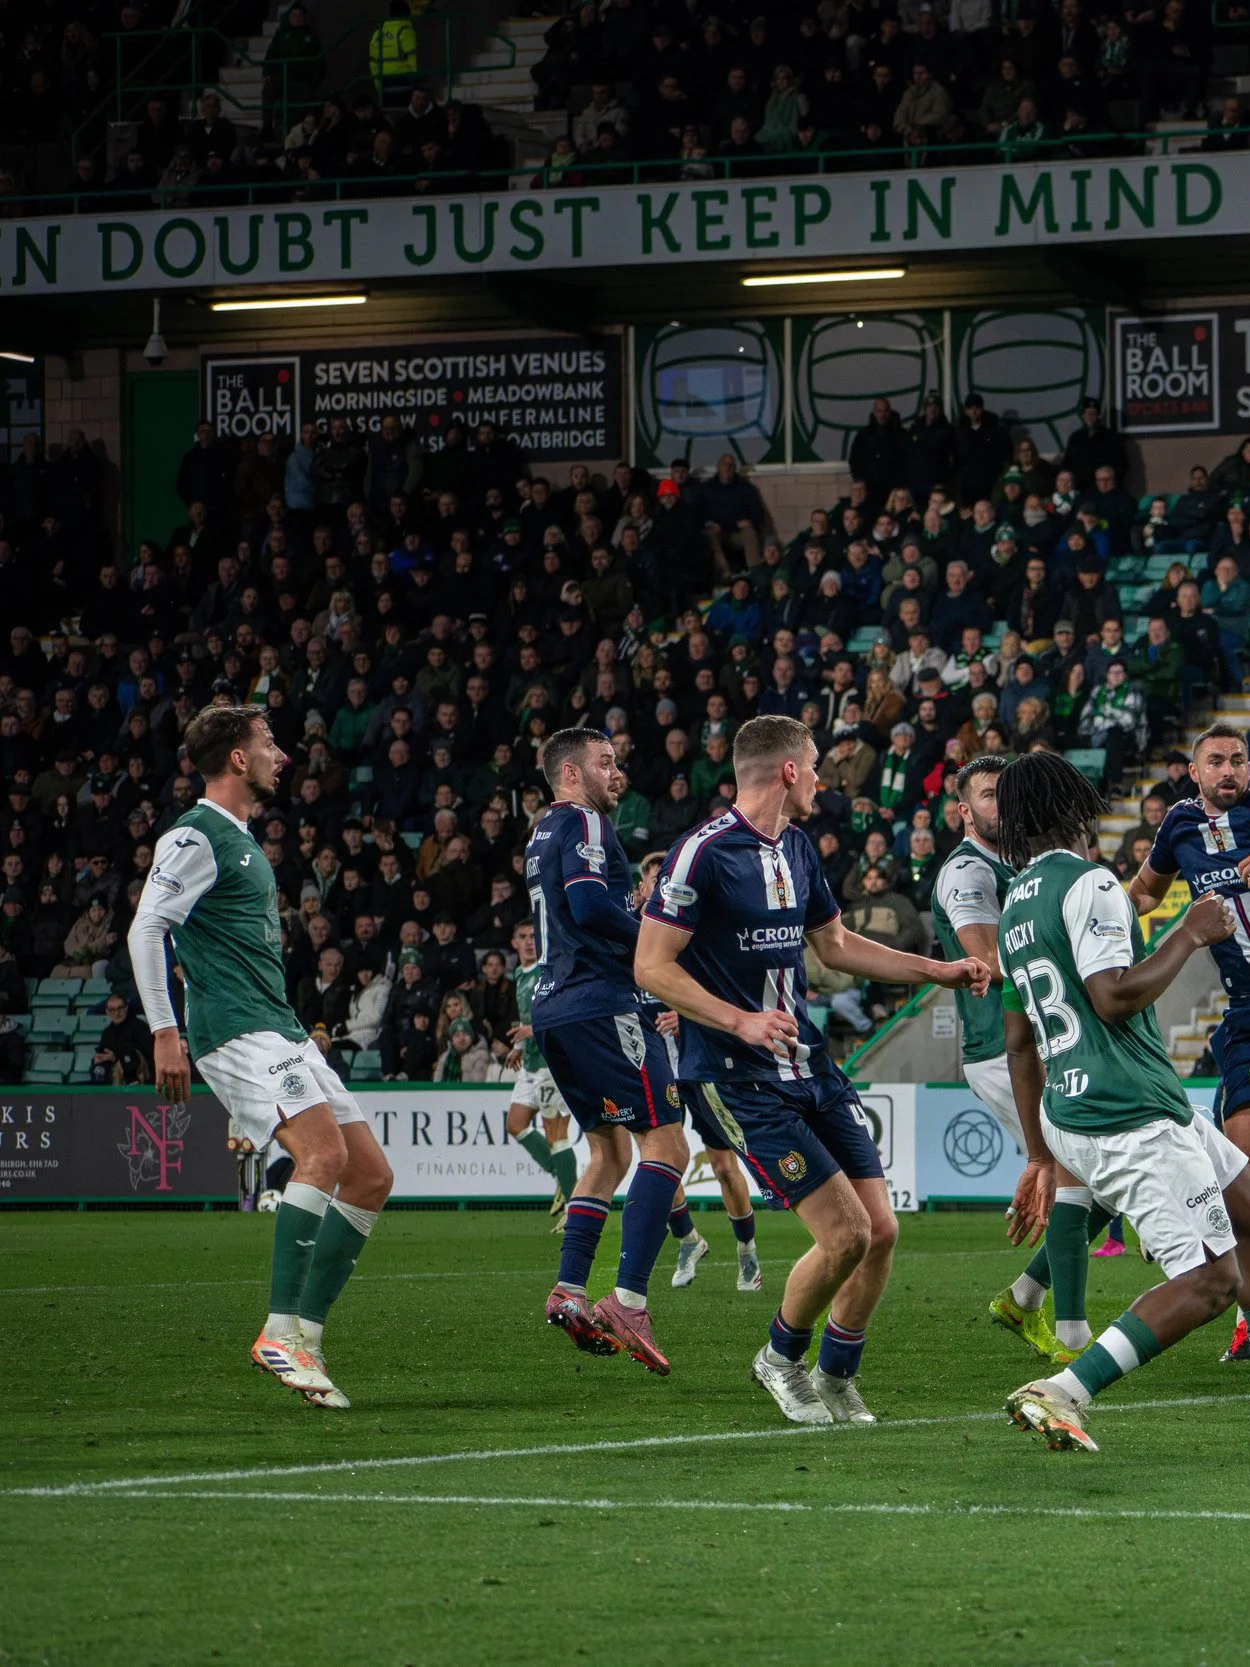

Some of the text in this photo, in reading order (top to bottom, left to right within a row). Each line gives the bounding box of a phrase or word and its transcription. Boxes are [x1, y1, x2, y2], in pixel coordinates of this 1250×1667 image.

[0, 225, 61, 286] N
[98, 209, 369, 281] DOUBT
[404, 198, 599, 267] JUST
[640, 184, 832, 255] KEEP
[870, 177, 956, 242] IN
[994, 164, 1222, 236] MIND
[1126, 332, 1158, 348] THE
[314, 350, 607, 386] SEVEN SCOTTISH VENUES
[1125, 344, 1209, 373] BALL
[216, 374, 245, 389] THE
[1125, 371, 1209, 399] ROOM
[216, 386, 291, 414] BALL
[314, 381, 605, 412] MORNINGSIDE MEADOWBANK
[216, 412, 292, 438] ROOM
[315, 411, 417, 433] GSGW
[502, 428, 606, 450] OATBRIDGE
[1005, 919, 1036, 955] ROCKY
[268, 1055, 304, 1075] Capital
[540, 1087, 556, 1104] 17
[416, 1161, 507, 1176] FINANCIAL
